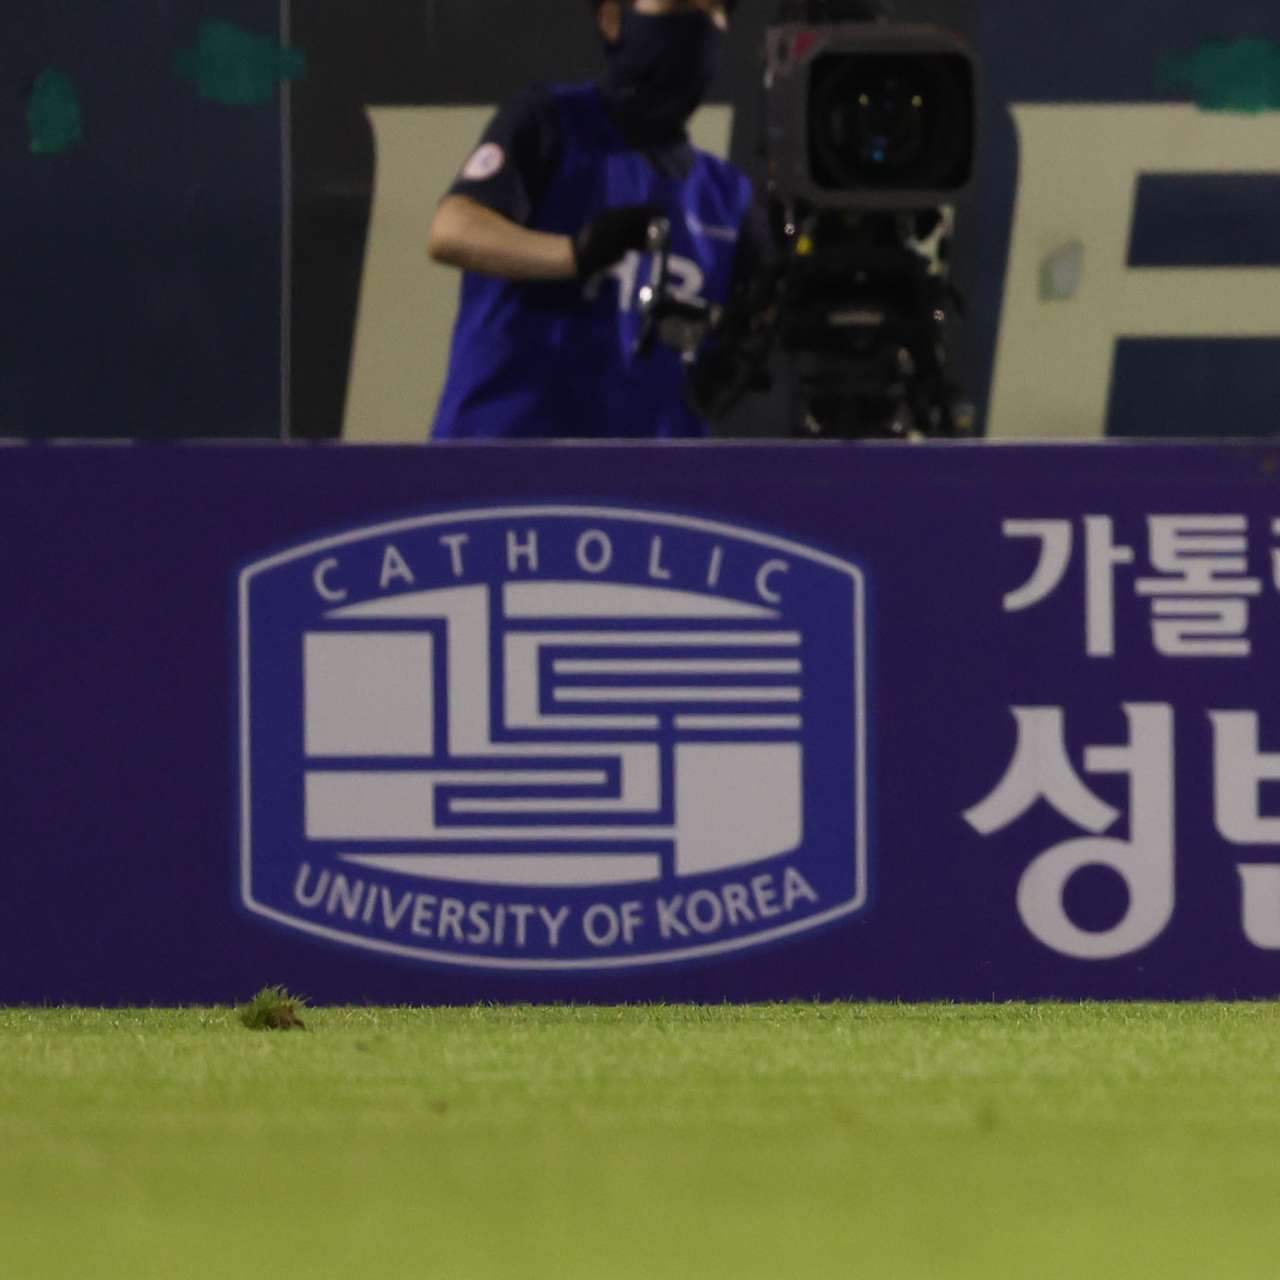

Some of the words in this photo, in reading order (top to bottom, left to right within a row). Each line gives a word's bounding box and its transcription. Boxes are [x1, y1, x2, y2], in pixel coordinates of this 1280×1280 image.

[311, 528, 791, 607] CATHOLIC
[293, 862, 571, 949] UNIVERSITY
[582, 900, 646, 949] OF
[657, 865, 821, 940] KOREA
